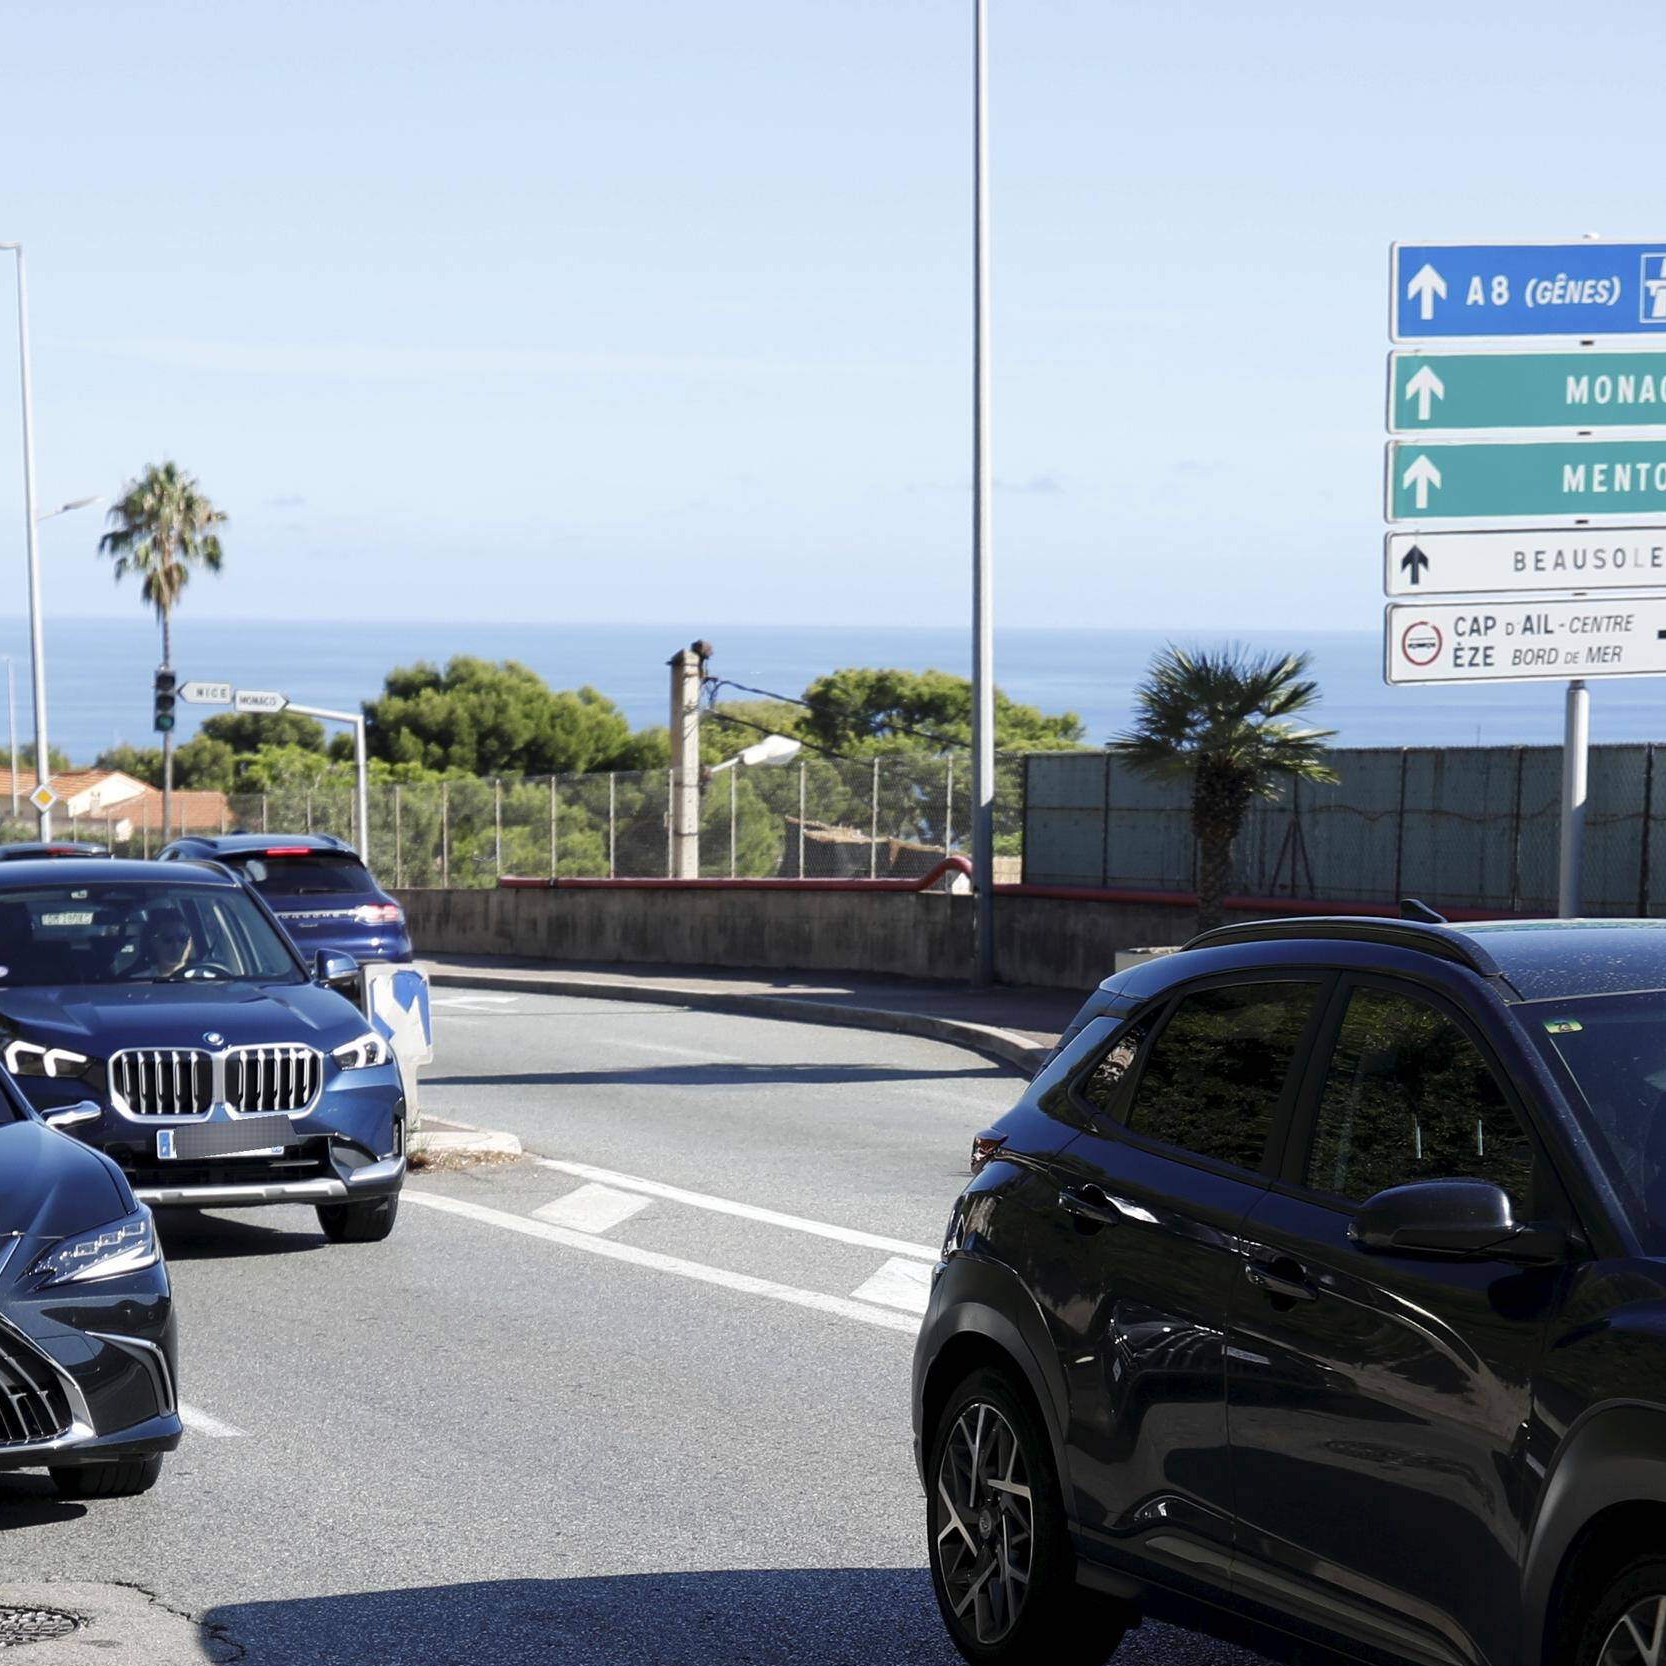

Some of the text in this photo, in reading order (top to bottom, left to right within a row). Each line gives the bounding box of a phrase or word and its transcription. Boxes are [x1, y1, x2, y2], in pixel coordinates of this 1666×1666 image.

[1525, 272, 1621, 308] (GÊNES)
[1454, 615, 1496, 637] CAP
[1511, 648, 1559, 666] BORD
[1564, 651, 1580, 665] DE
[1585, 645, 1623, 664] MER
[196, 687, 227, 698] NICE
